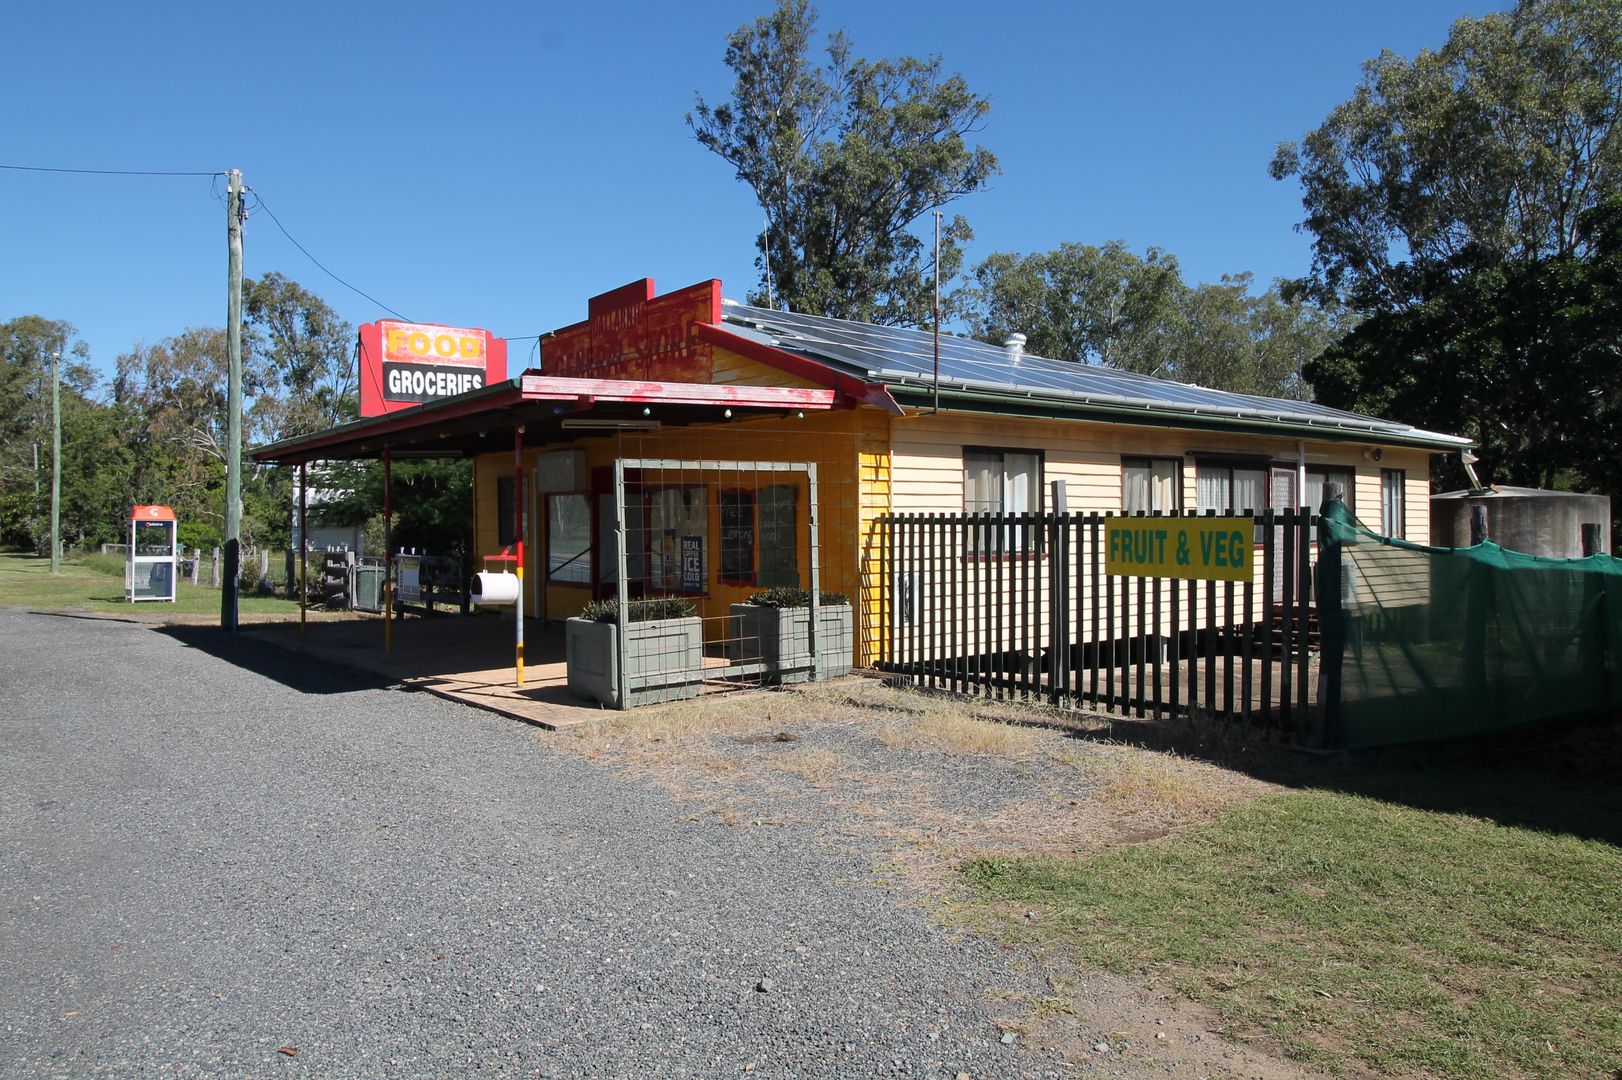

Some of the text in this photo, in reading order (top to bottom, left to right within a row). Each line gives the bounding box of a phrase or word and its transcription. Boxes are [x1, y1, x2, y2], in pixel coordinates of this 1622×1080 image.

[388, 330, 480, 359] FOOD
[388, 369, 482, 396] GROCERIES
[683, 540, 699, 550] REAL
[1110, 528, 1245, 568] FRUIT & VEG
[683, 557, 700, 572] ICE
[683, 572, 700, 582] COLD
